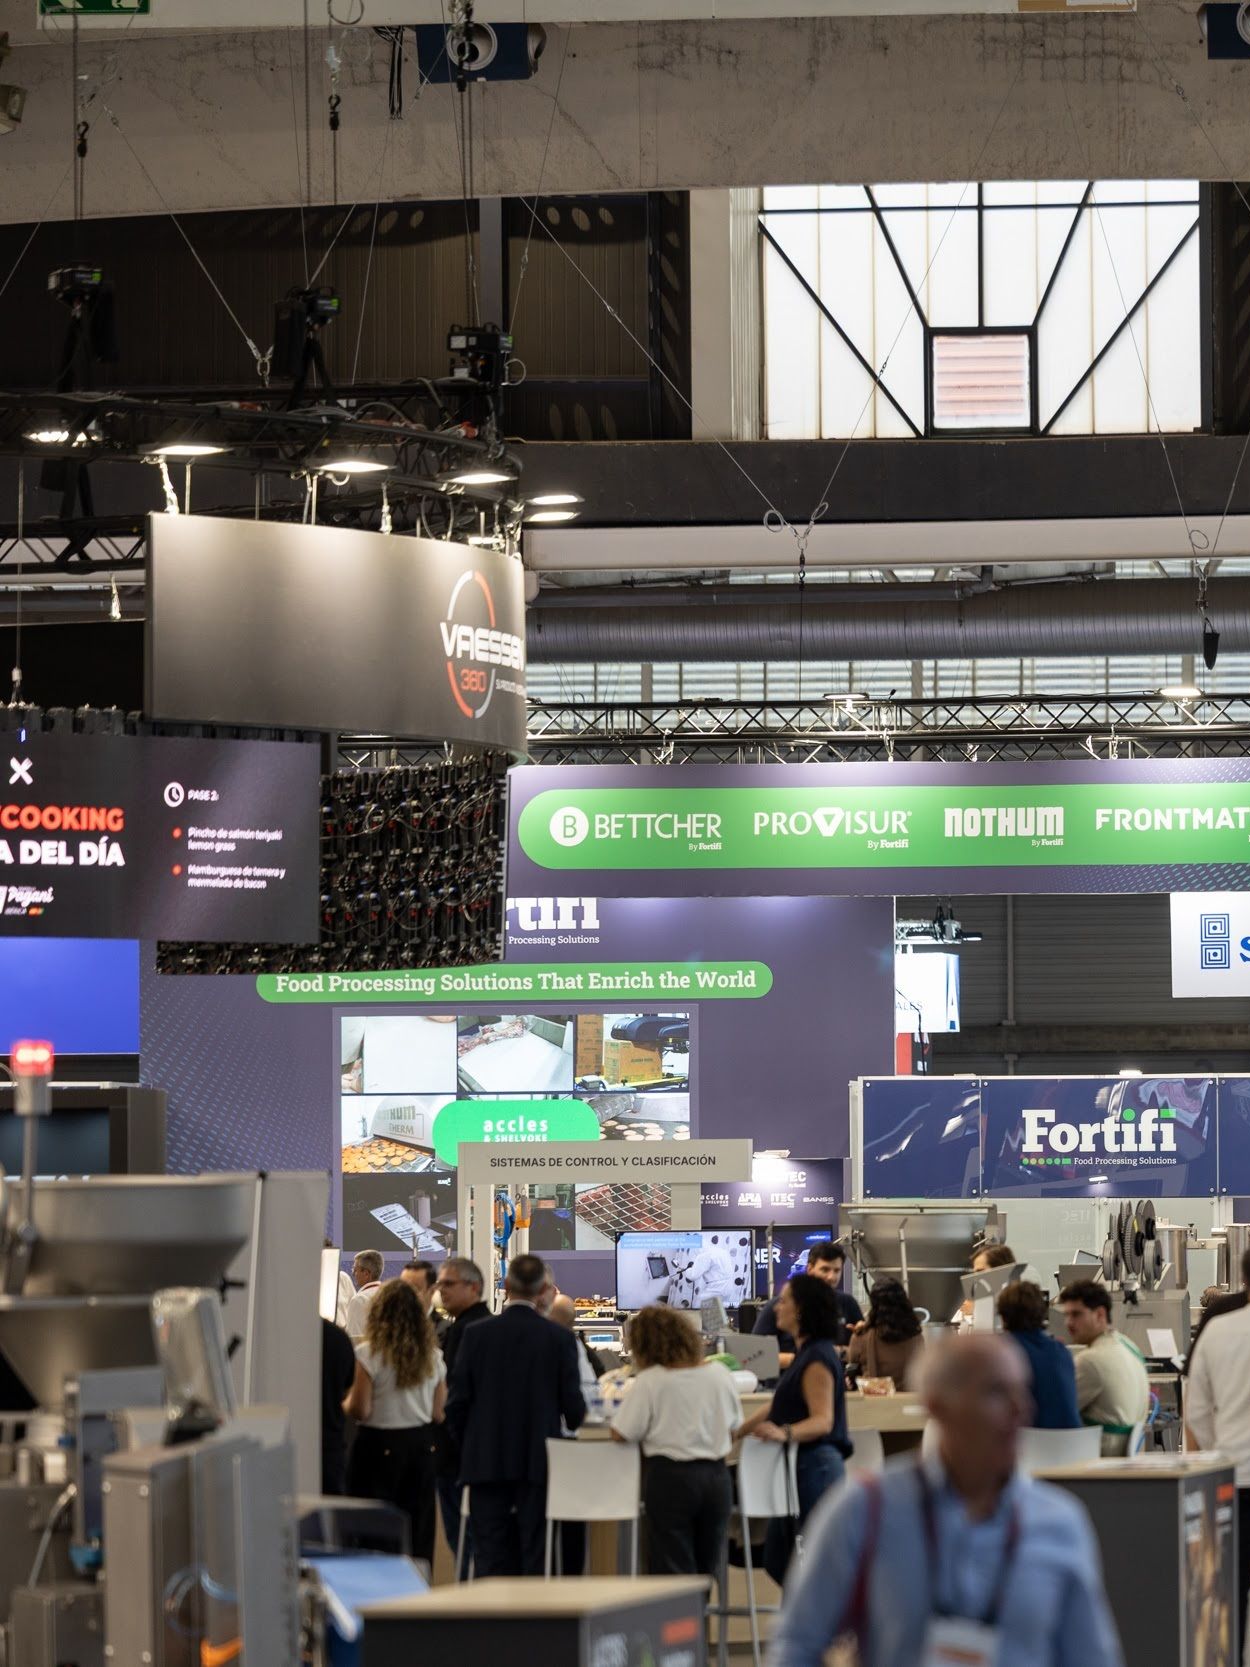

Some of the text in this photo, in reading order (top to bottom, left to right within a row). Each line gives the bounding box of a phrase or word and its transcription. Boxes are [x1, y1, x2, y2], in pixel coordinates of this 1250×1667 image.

[460, 669, 487, 692] 360
[0, 805, 124, 831] COOKING
[944, 806, 1064, 837] NOTHUM
[187, 827, 216, 838] Pincho
[594, 813, 722, 839] BETTCHER
[688, 842, 722, 851] By Fortifi
[867, 839, 909, 850] By Fortifi
[1041, 838, 1064, 846] Fortifi
[20, 840, 74, 865] DEL
[79, 836, 125, 866] DÍA
[508, 935, 600, 946] Processing Solutions
[276, 970, 756, 995] Food Processing Solutions That Enrich the World
[483, 1116, 548, 1133] accles
[1022, 1109, 1177, 1152] Fortifi
[495, 1134, 547, 1142] SHELVOKE
[490, 1154, 716, 1167] SISTEMAS DE CONTROL Y CLASIFICACIÓN
[1095, 1158, 1138, 1166] Processing
[1139, 1157, 1177, 1165] Solutions
